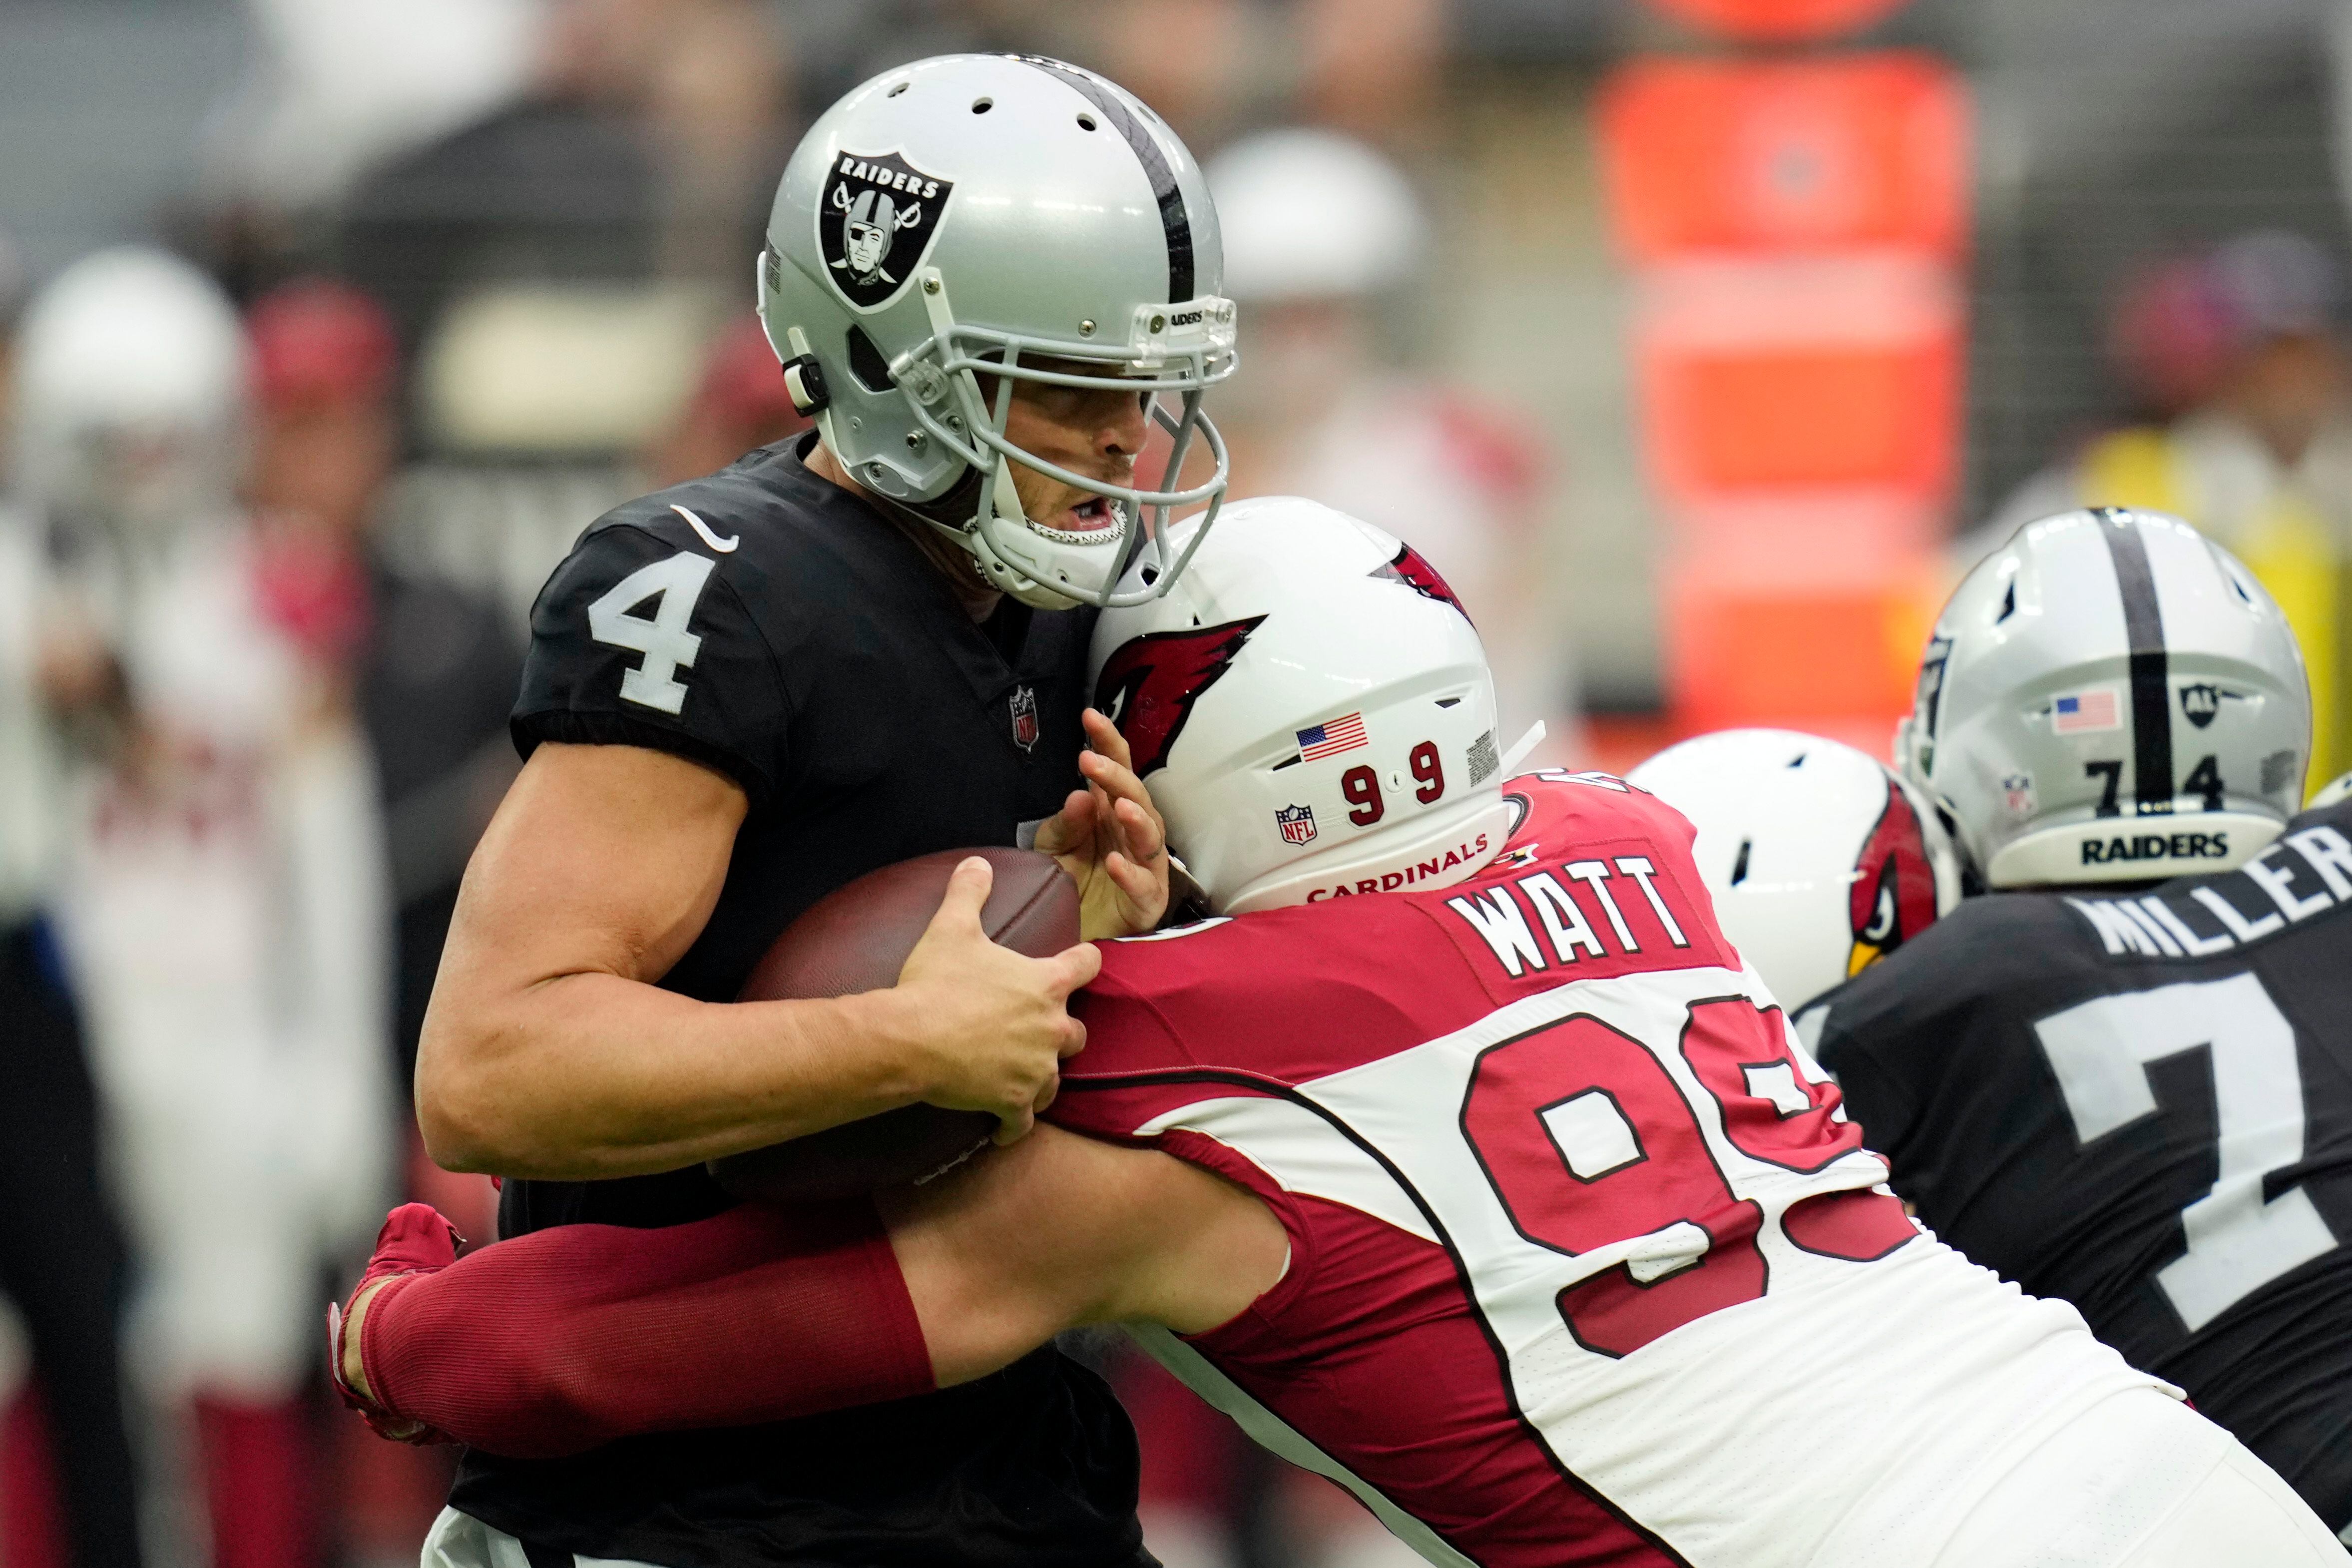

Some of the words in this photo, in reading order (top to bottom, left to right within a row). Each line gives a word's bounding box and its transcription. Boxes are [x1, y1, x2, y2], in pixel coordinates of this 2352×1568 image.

[839, 157, 940, 199] RAIDERS
[587, 550, 716, 715] 4
[1282, 821, 1315, 841] NFL
[1307, 833, 1488, 904] CARDINALS
[2062, 825, 2352, 957] MILLER
[2081, 832, 2229, 866] RAIDERS
[1442, 855, 1691, 980] WATT
[1459, 993, 1923, 1360] 99
[2034, 971, 2340, 1334] 7
